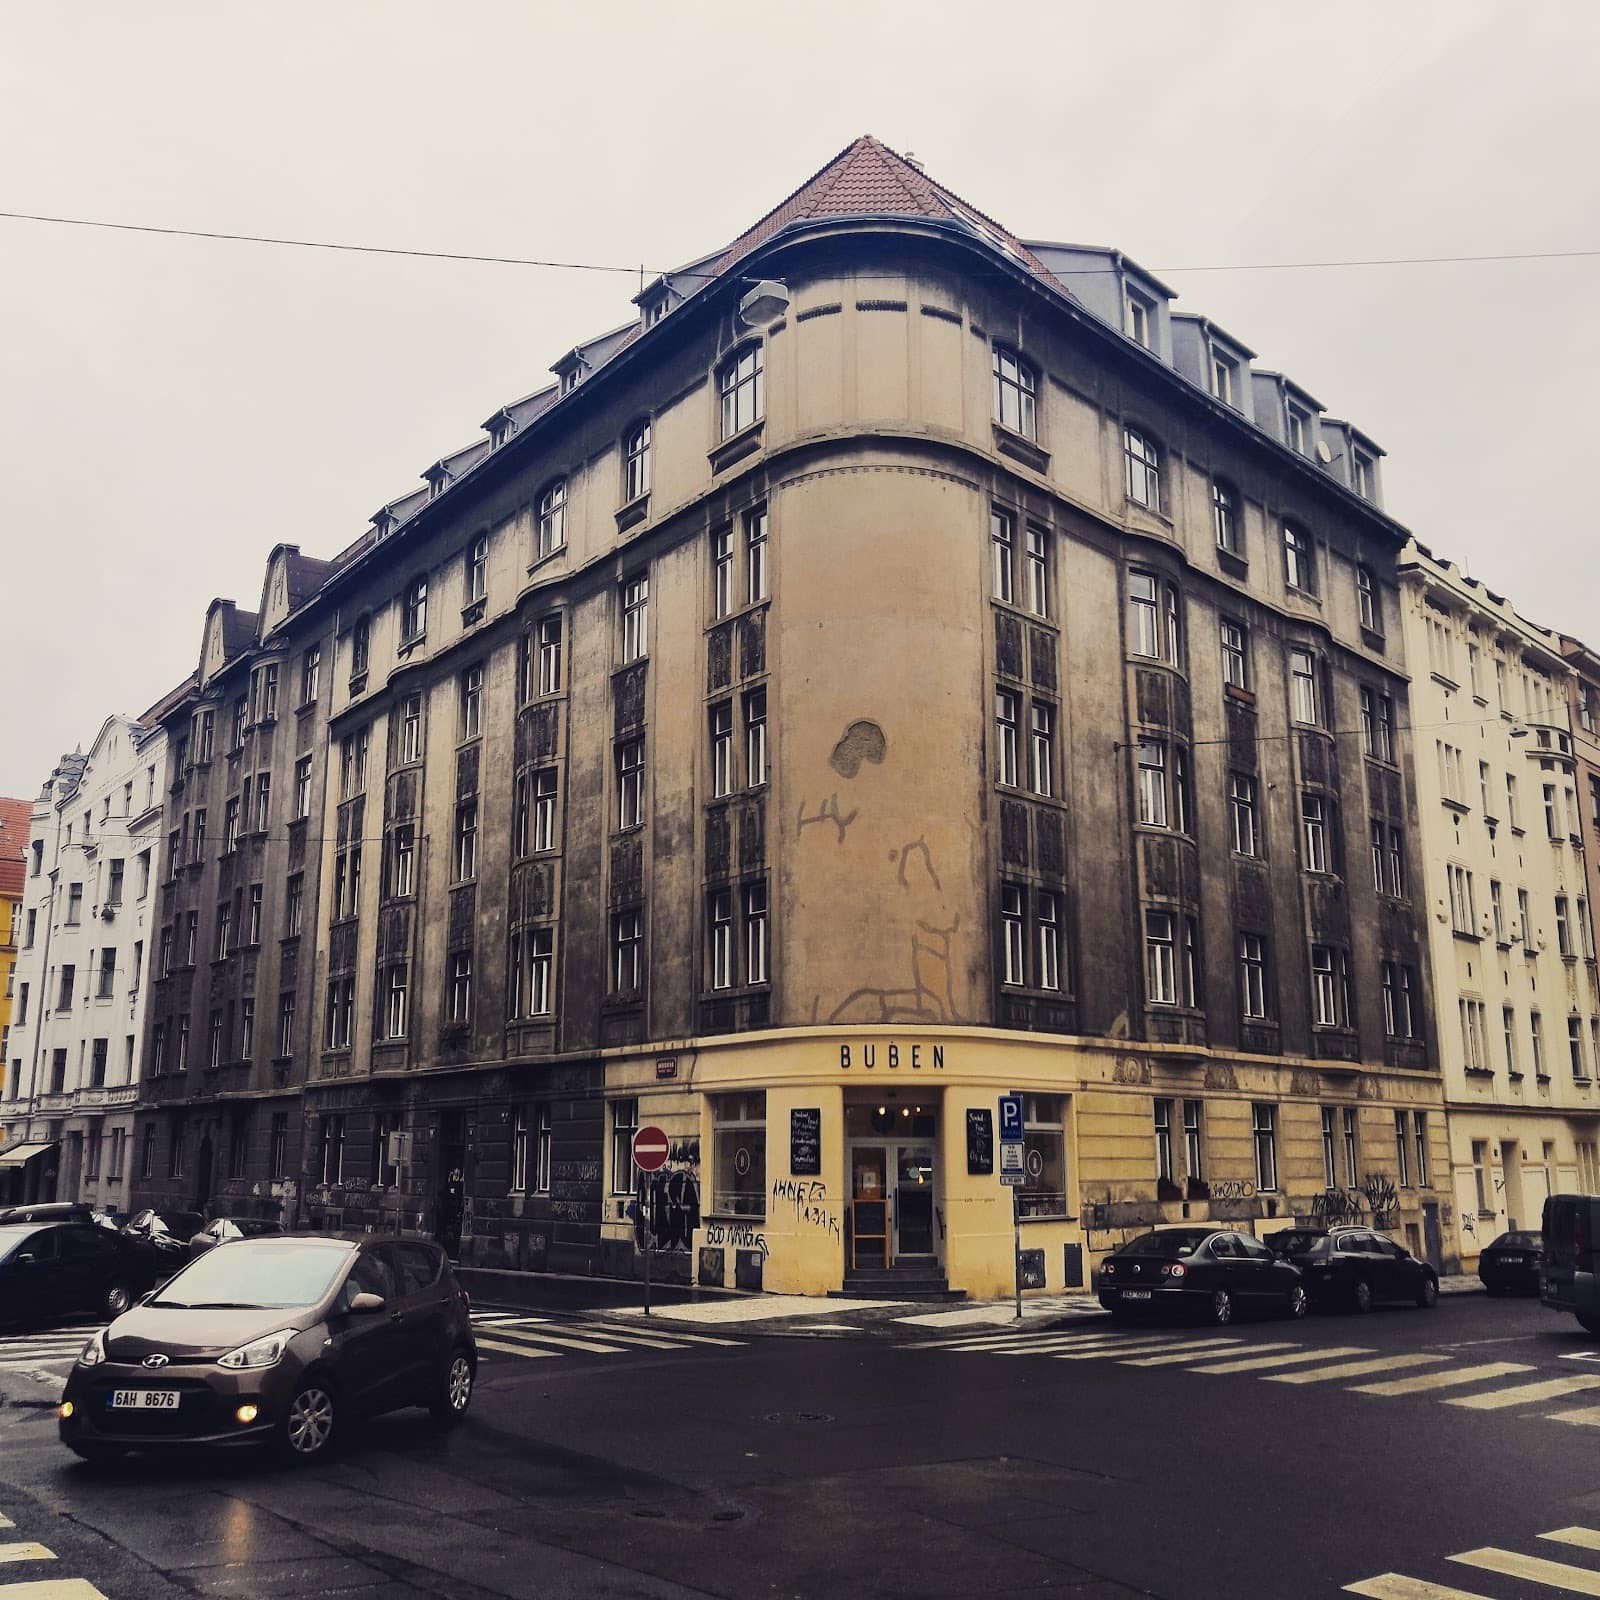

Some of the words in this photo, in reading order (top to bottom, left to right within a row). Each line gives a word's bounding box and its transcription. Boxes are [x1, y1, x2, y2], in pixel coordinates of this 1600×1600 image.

[841, 1044, 944, 1069] BUBEN
[1003, 1102, 1018, 1128] P
[115, 1392, 137, 1406] 6AH
[145, 1392, 175, 1407] 8676
